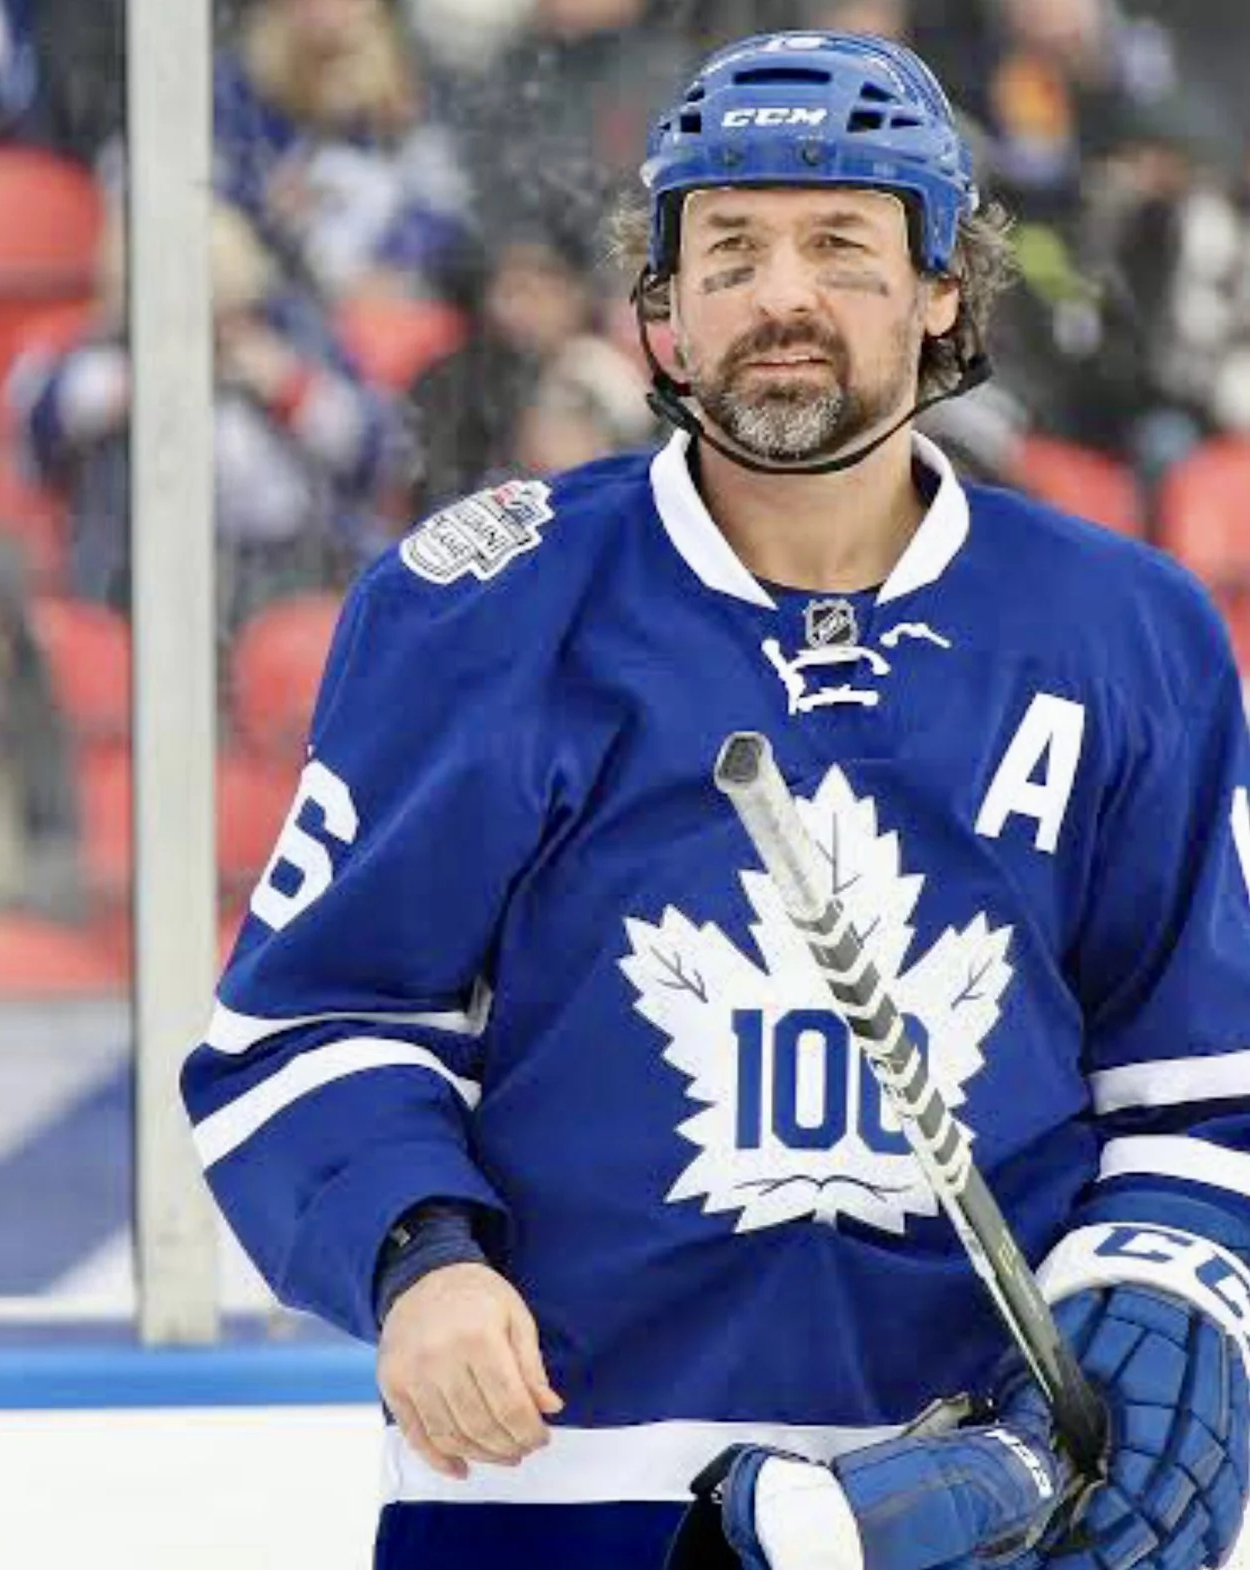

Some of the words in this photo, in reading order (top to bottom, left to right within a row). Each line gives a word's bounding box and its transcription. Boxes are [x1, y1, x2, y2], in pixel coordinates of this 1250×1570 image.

[720, 107, 827, 127] CCM
[250, 759, 360, 932] 6
[974, 692, 1085, 854] A
[731, 1009, 929, 1155] 100
